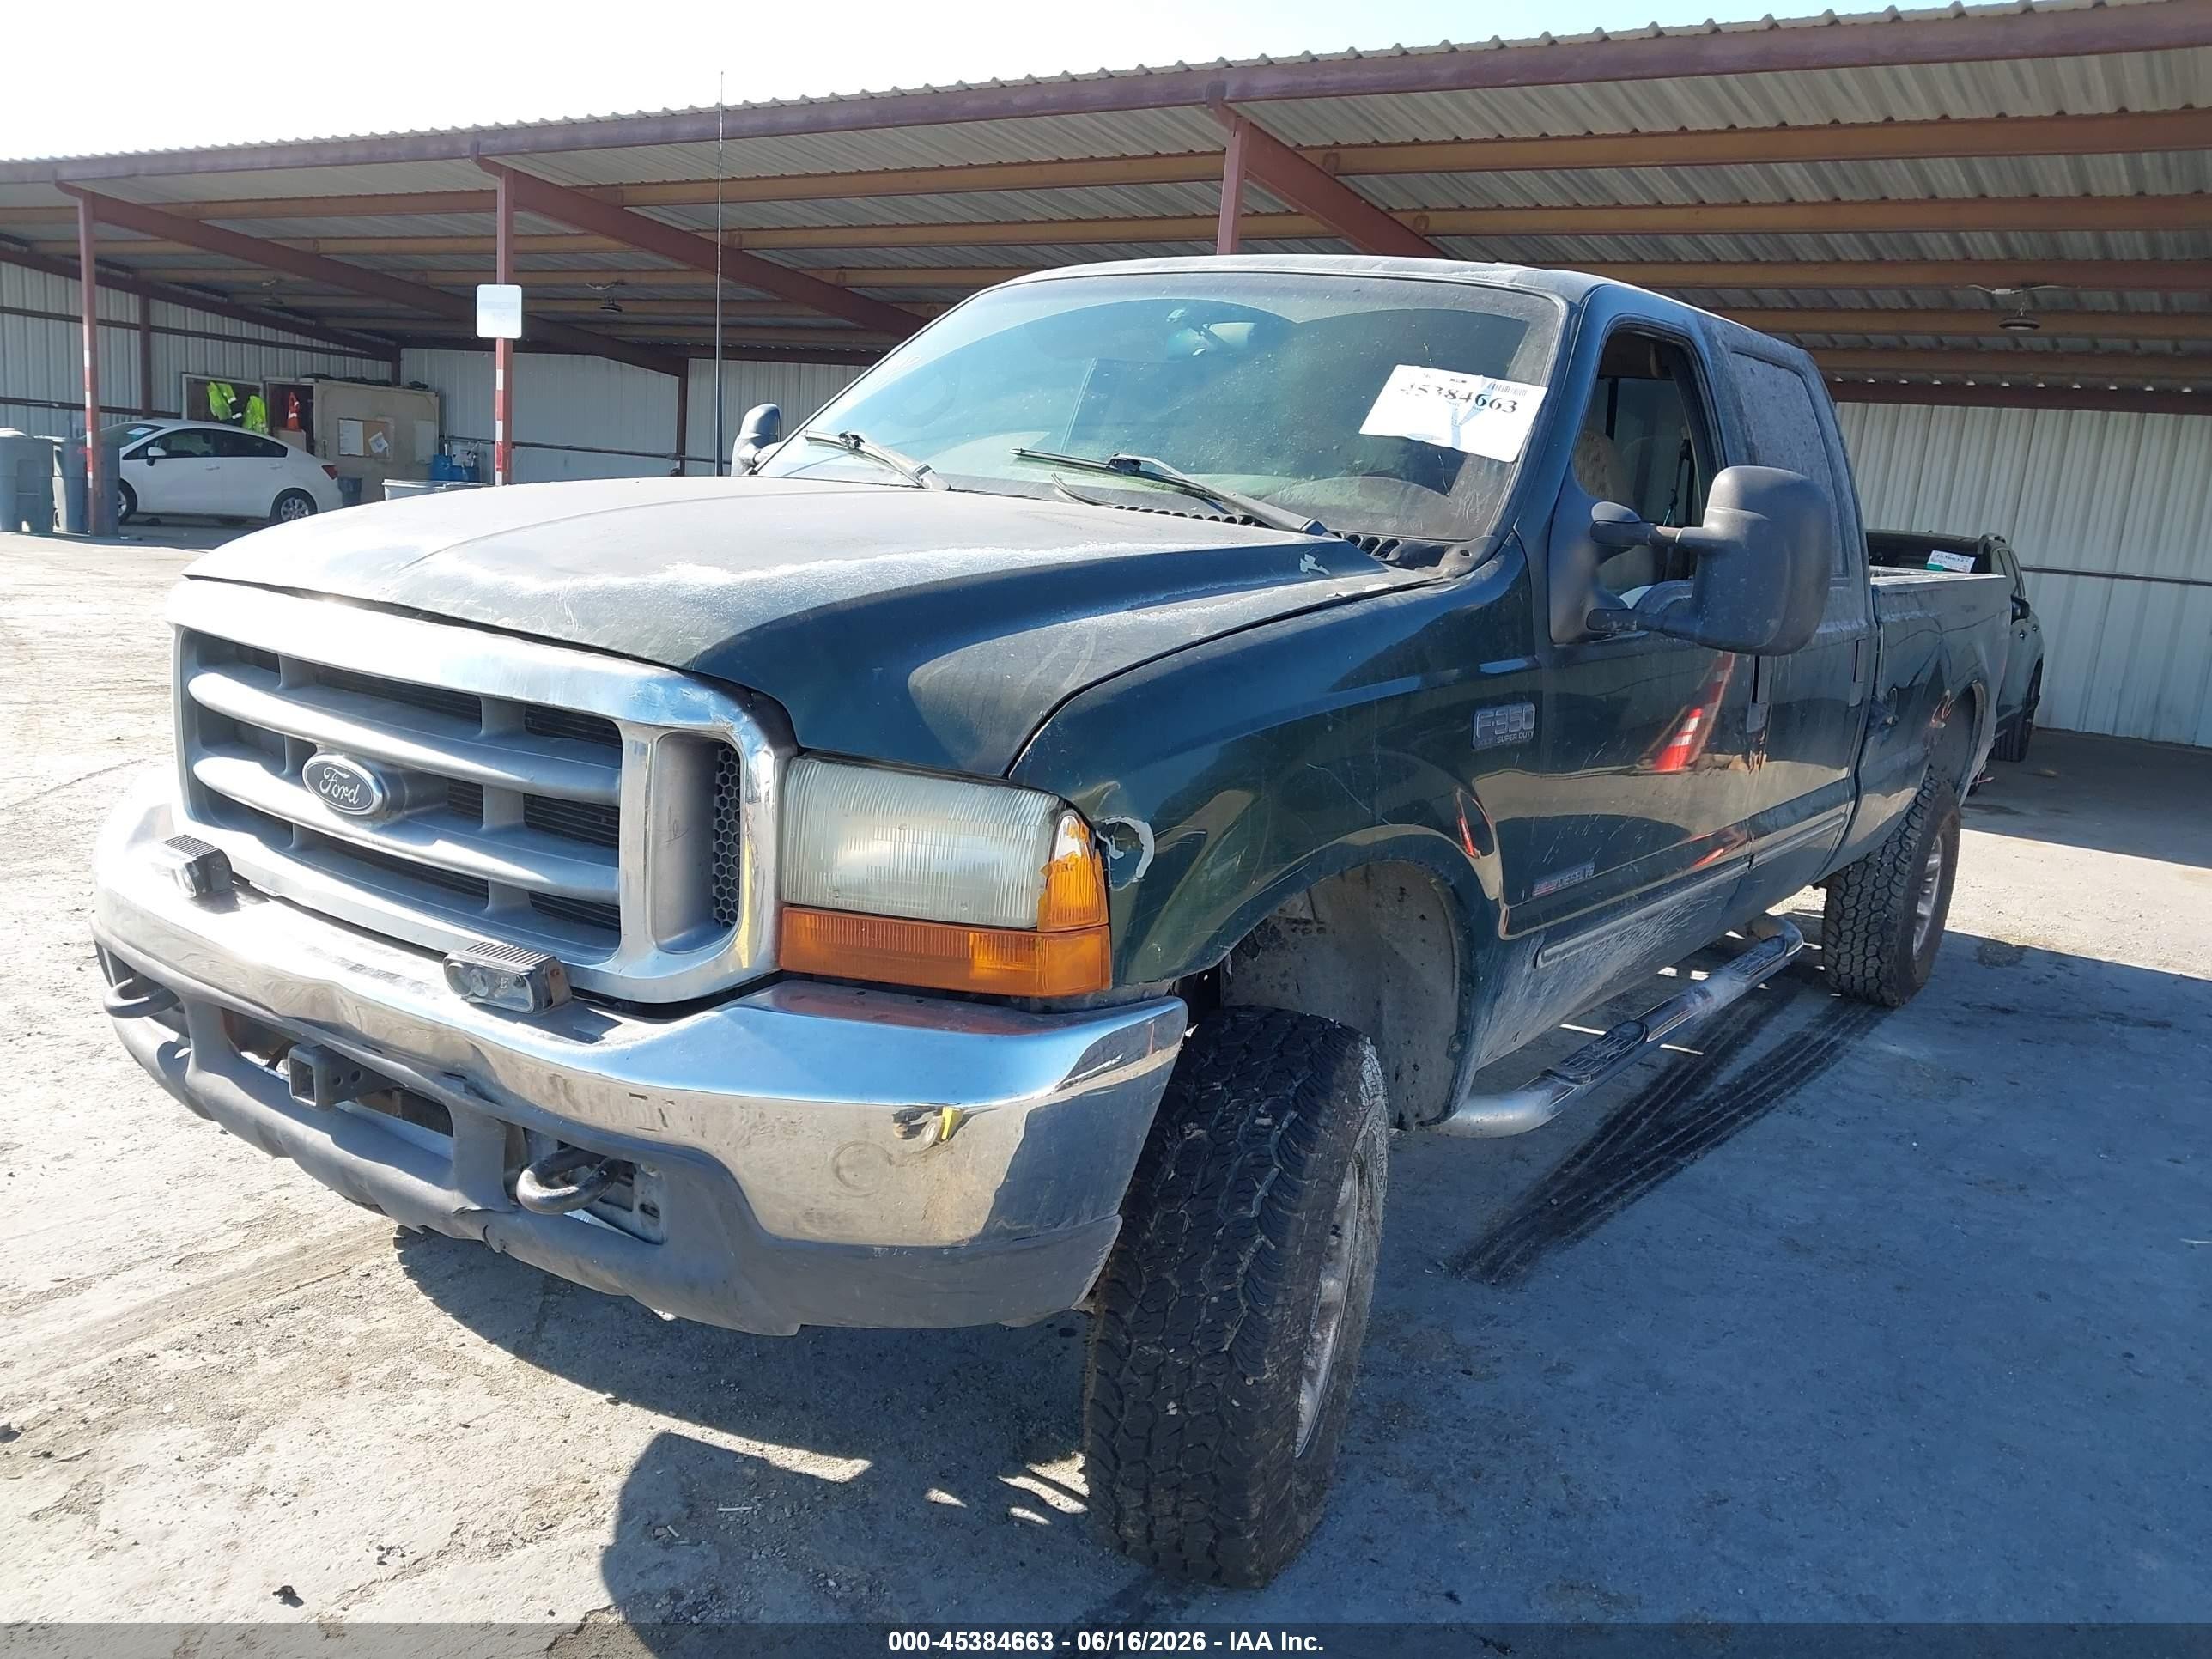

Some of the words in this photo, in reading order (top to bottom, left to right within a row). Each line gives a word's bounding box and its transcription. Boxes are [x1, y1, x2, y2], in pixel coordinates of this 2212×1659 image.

[1476, 704, 1535, 738] F-350
[1497, 733, 1517, 744] SUPER
[1518, 730, 1534, 741] DUTY
[319, 767, 360, 805] Ford
